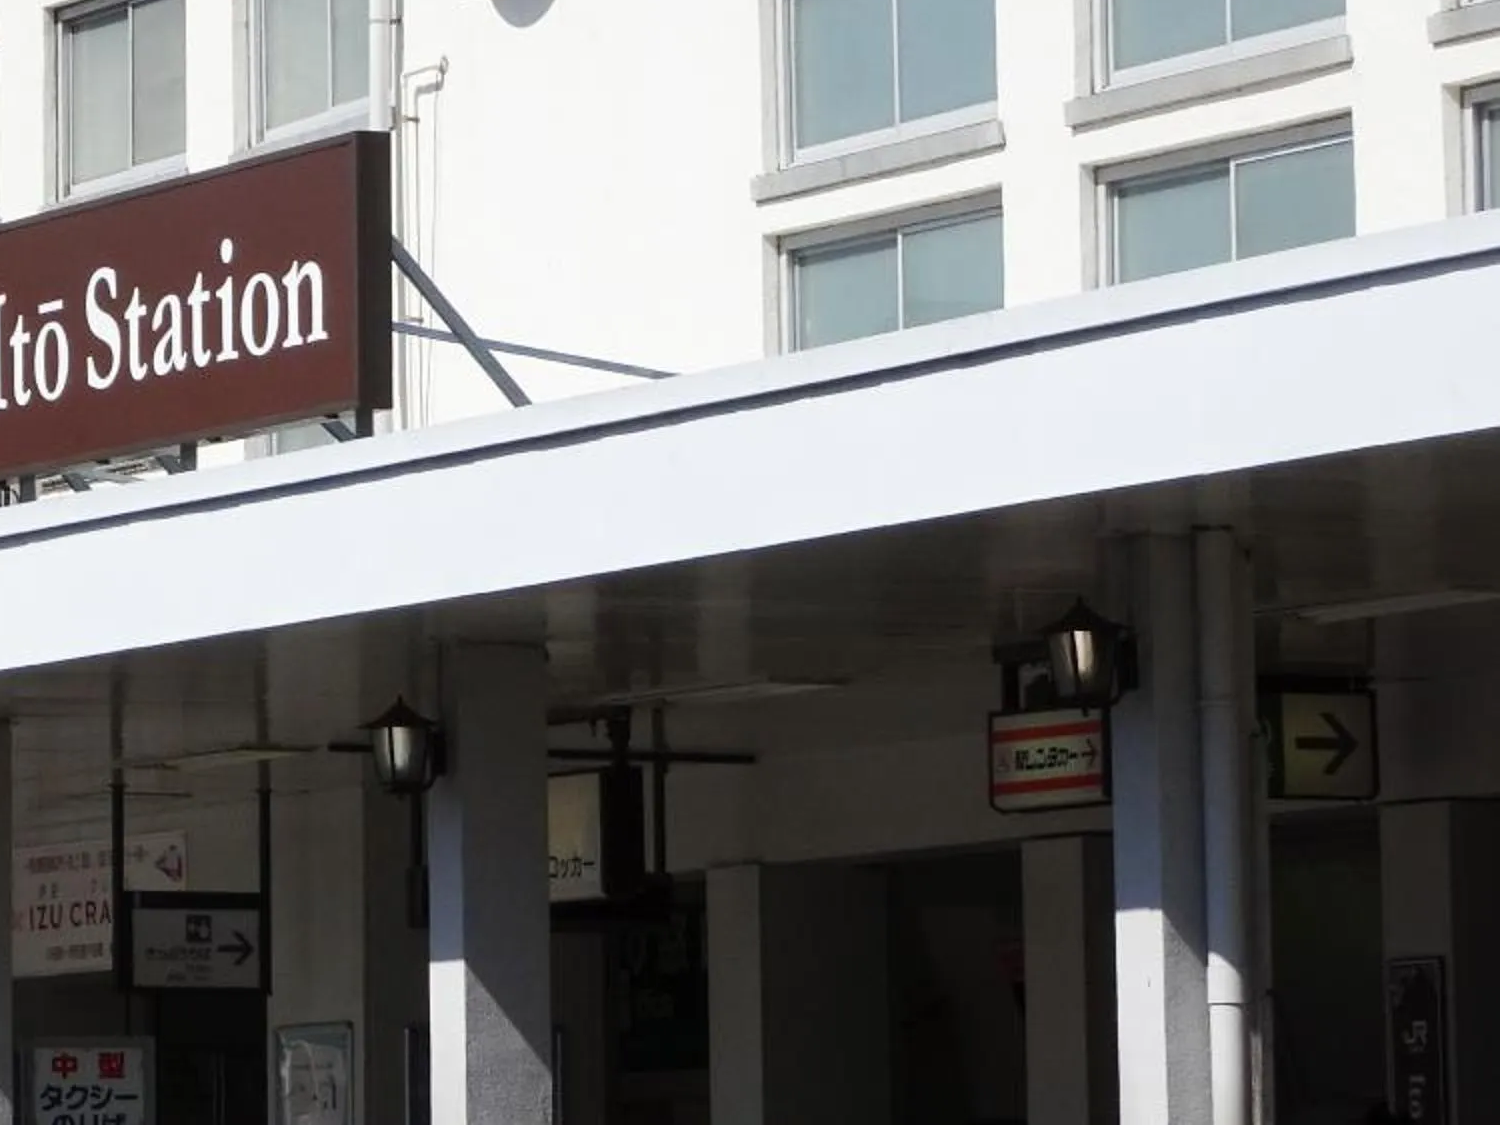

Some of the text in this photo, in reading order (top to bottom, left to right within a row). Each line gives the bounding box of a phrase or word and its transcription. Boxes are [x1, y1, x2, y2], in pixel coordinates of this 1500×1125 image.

[84, 237, 329, 390] Station
[29, 903, 64, 932] IZU
[40, 1082, 139, 1111] タクシー
